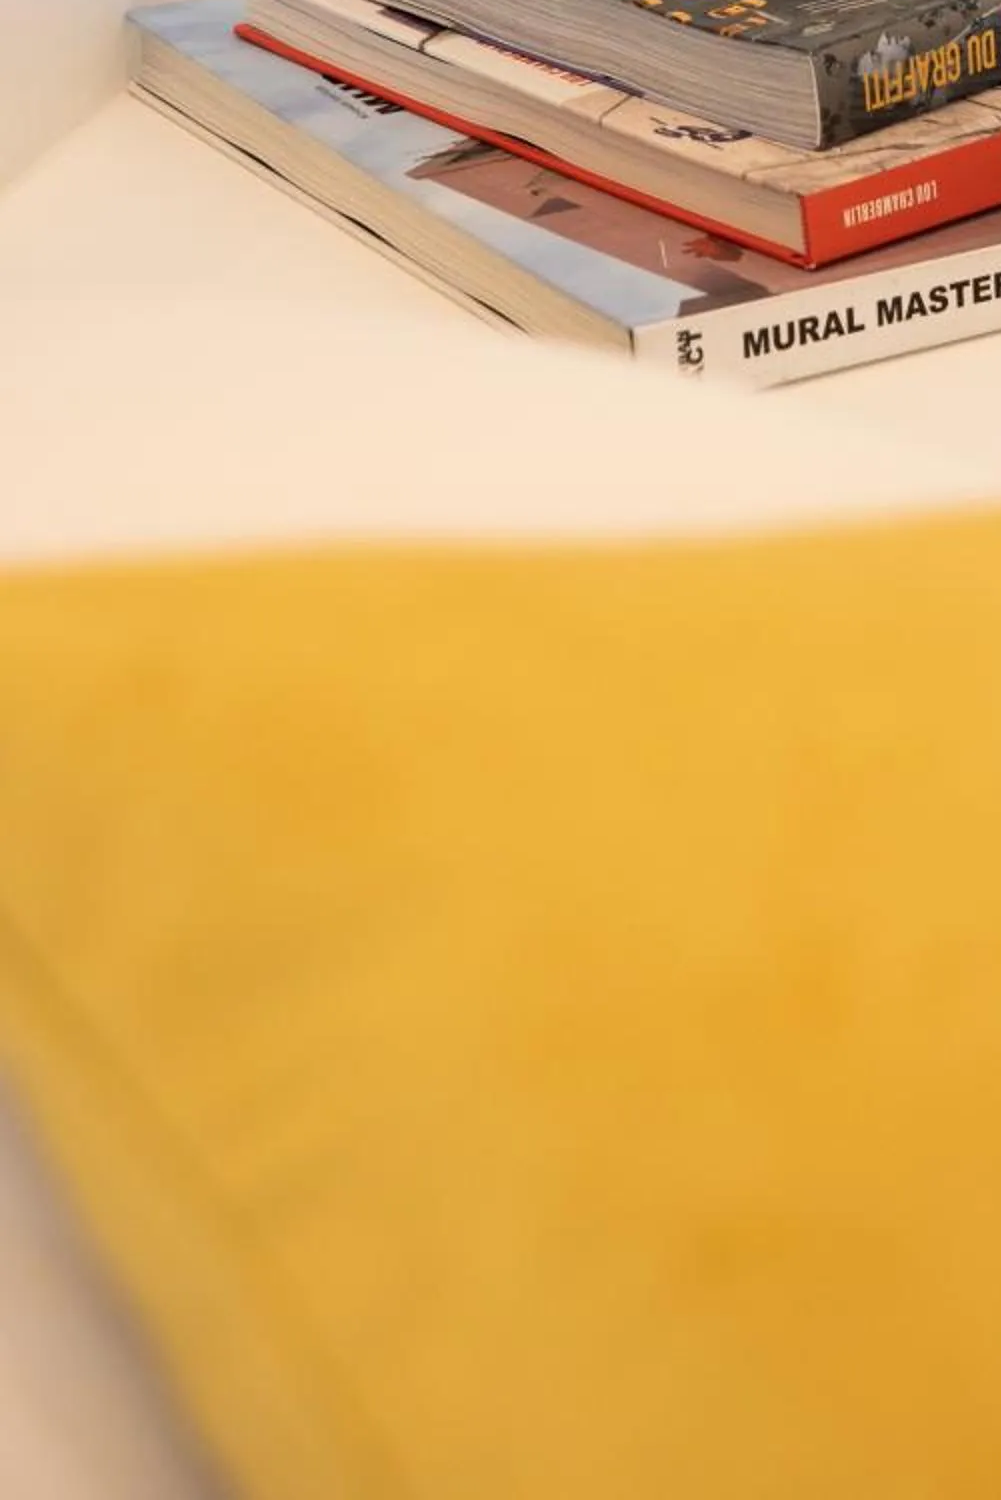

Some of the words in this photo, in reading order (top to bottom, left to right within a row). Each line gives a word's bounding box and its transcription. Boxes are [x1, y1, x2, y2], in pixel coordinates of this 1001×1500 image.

[967, 35, 996, 73] DU
[863, 45, 961, 113] GRAFFITI
[843, 185, 914, 229] CHAMBERLIN
[914, 180, 938, 208] LOU
[742, 305, 865, 359] MURAL
